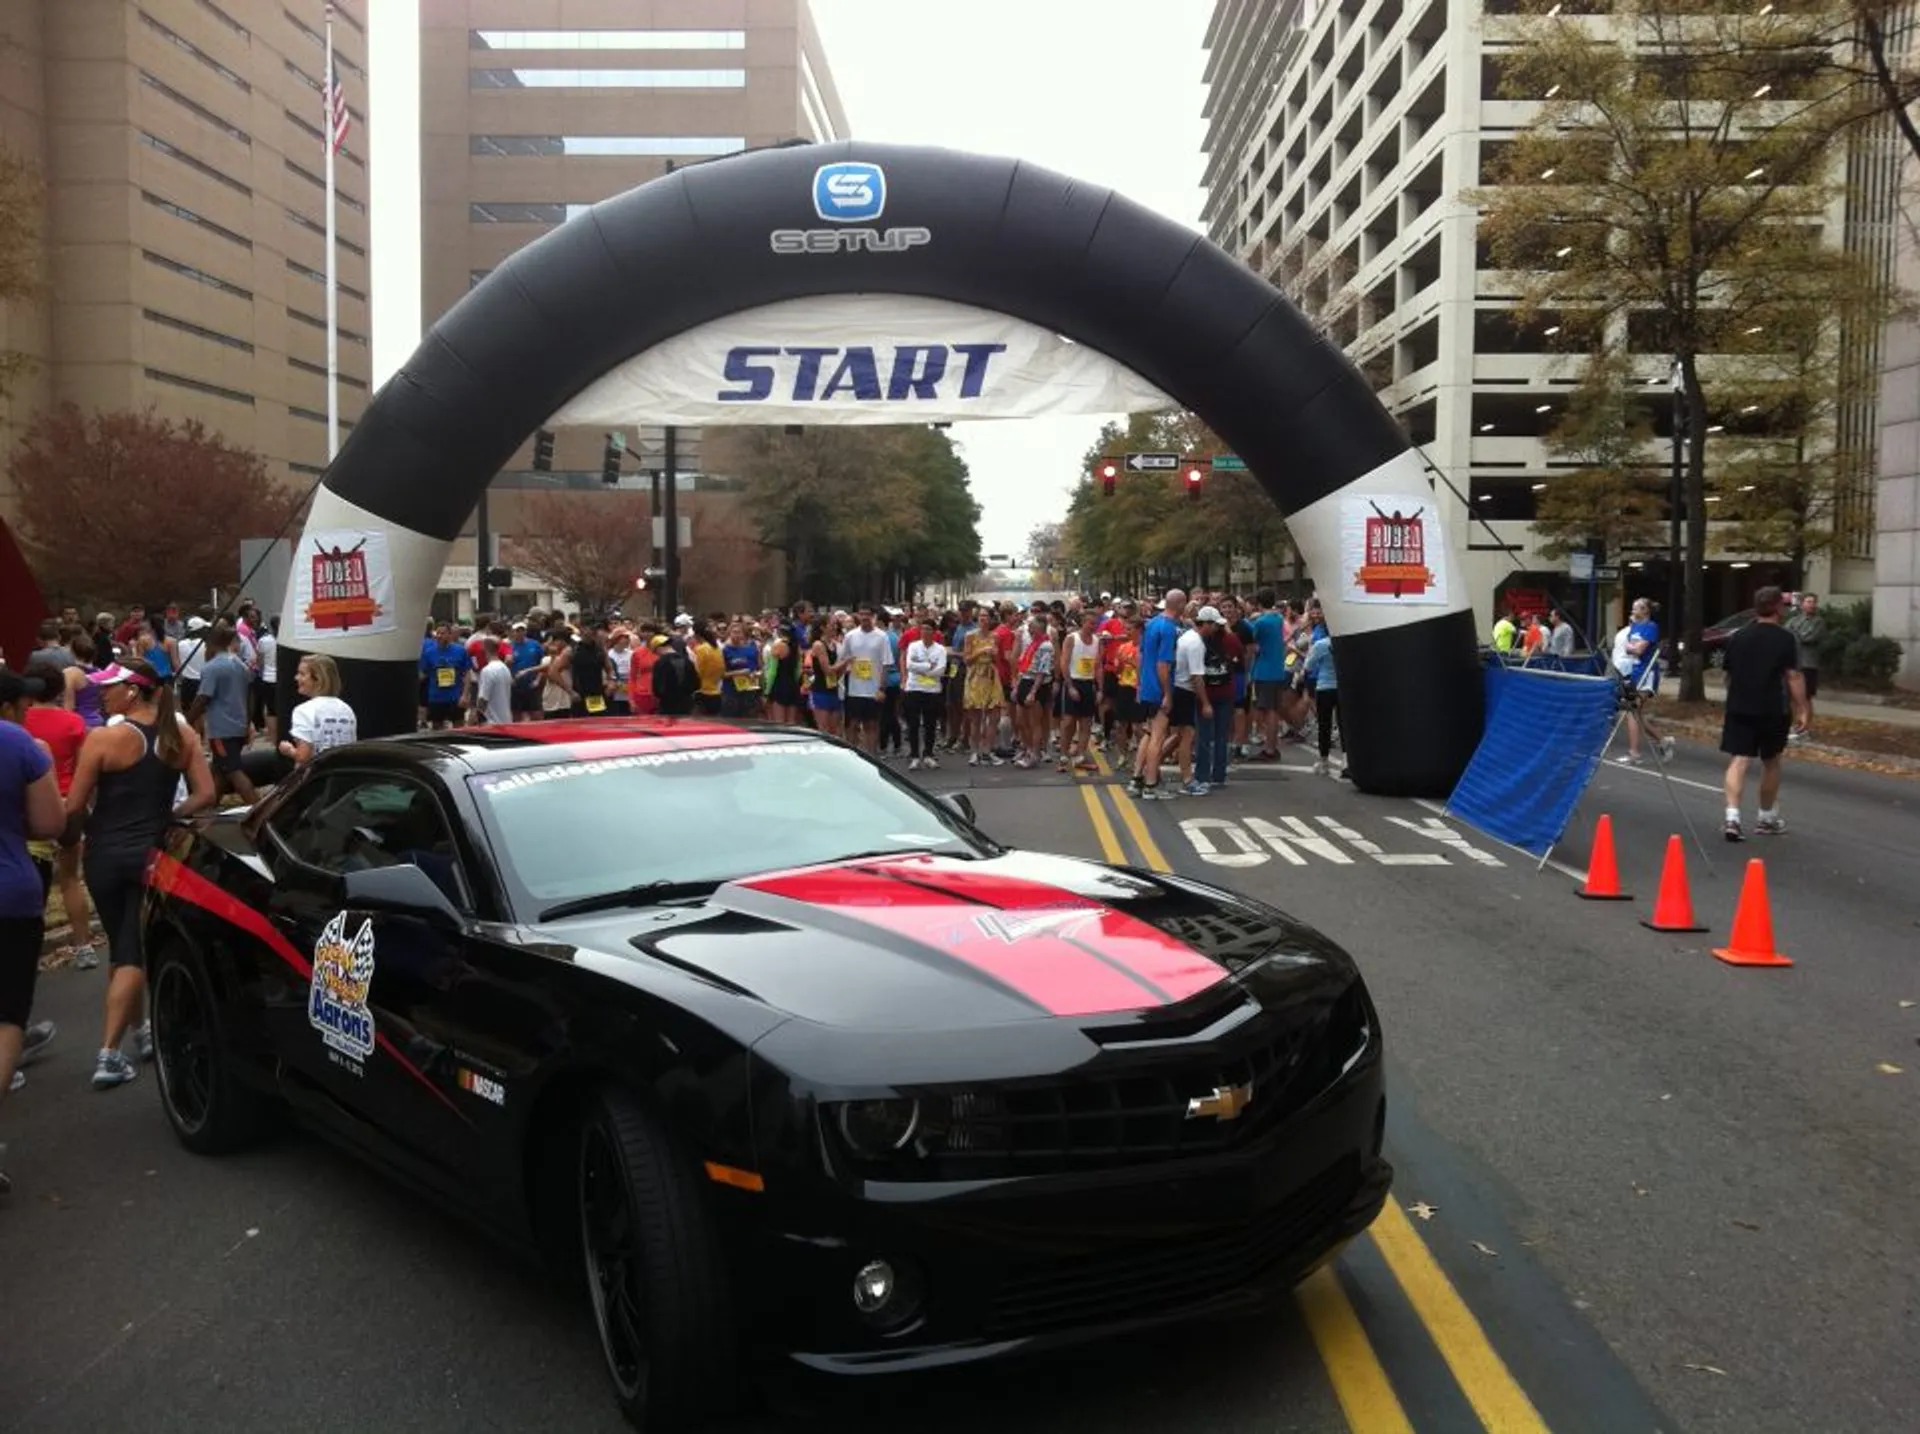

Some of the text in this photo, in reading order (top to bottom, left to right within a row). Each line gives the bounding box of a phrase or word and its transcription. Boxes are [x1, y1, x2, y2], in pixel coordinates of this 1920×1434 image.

[770, 227, 931, 254] SETUP
[717, 343, 1007, 401] START
[1178, 816, 1507, 867] ONLY
